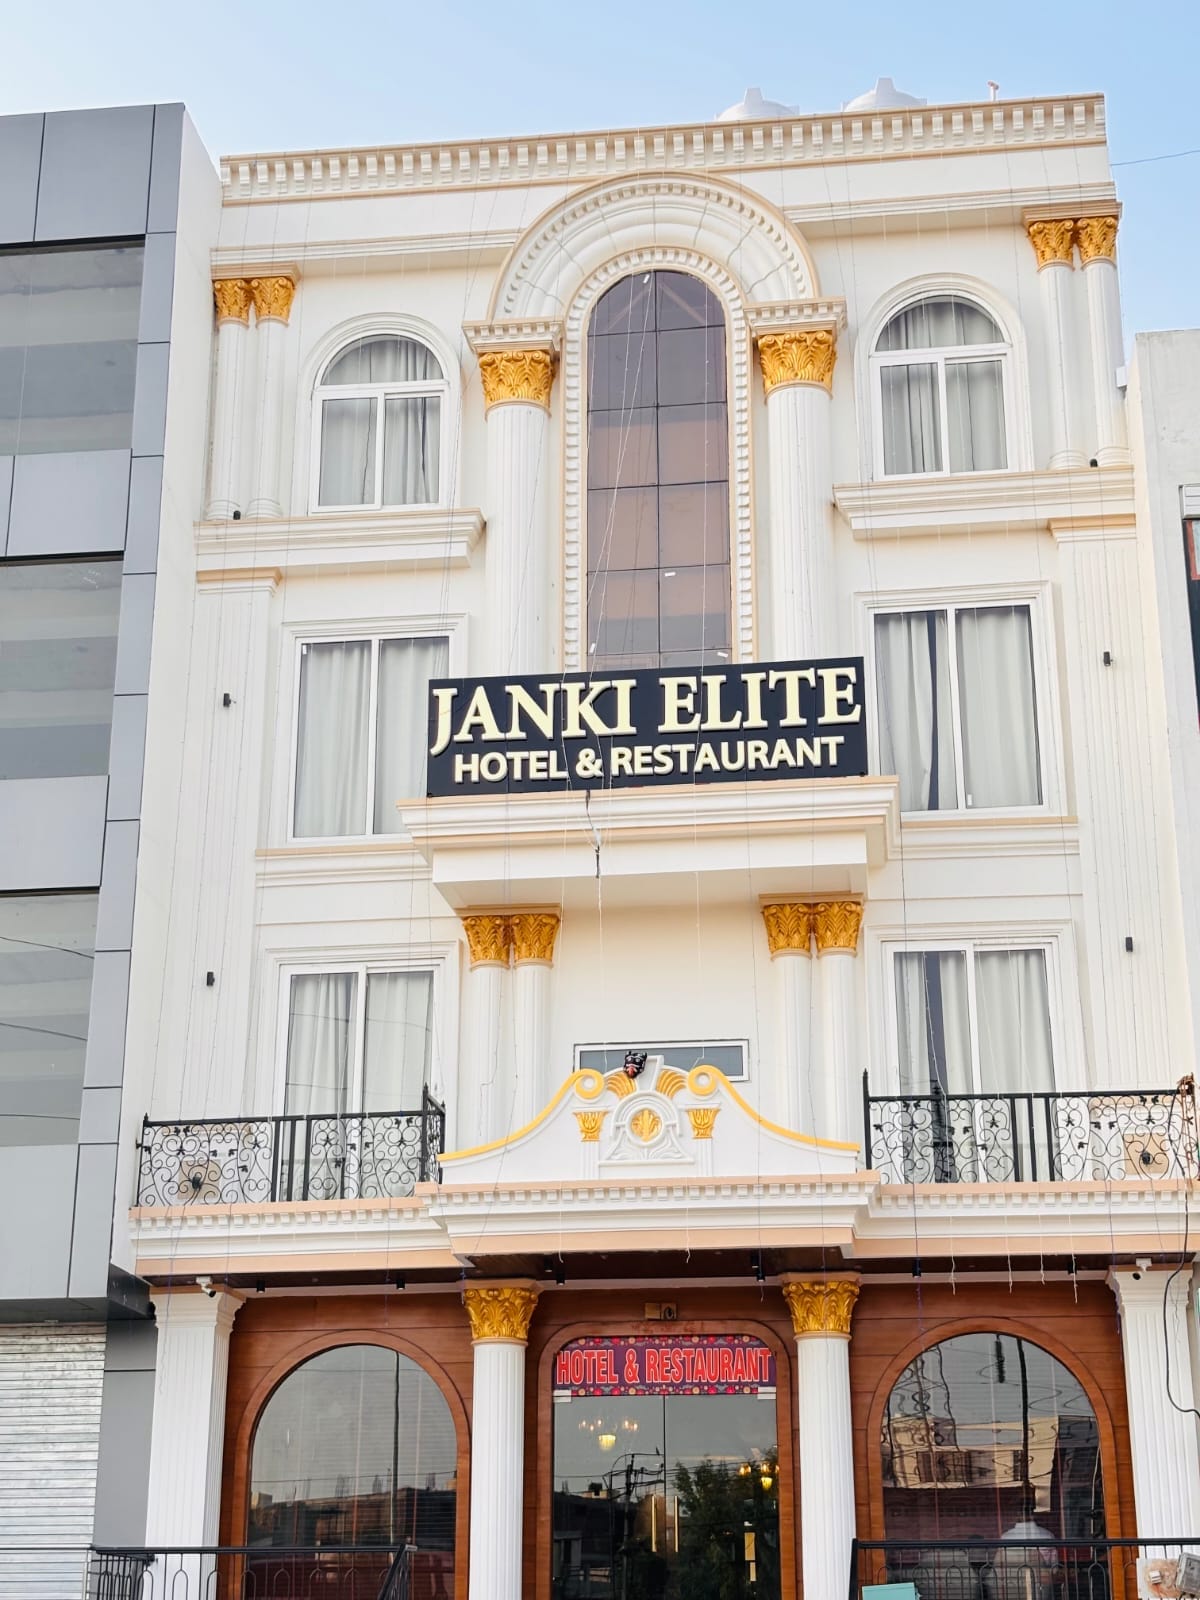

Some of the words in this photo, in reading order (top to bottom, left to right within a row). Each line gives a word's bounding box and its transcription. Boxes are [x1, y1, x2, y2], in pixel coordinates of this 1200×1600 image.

[430, 680, 637, 756] JANKI
[658, 667, 862, 733] ELITE
[455, 751, 567, 783] HOTEL
[575, 748, 604, 778] &
[612, 736, 844, 777] RESTAURANT
[556, 1350, 618, 1384] HOTEL
[624, 1349, 639, 1384] &
[645, 1347, 771, 1383] RESTAURANT
